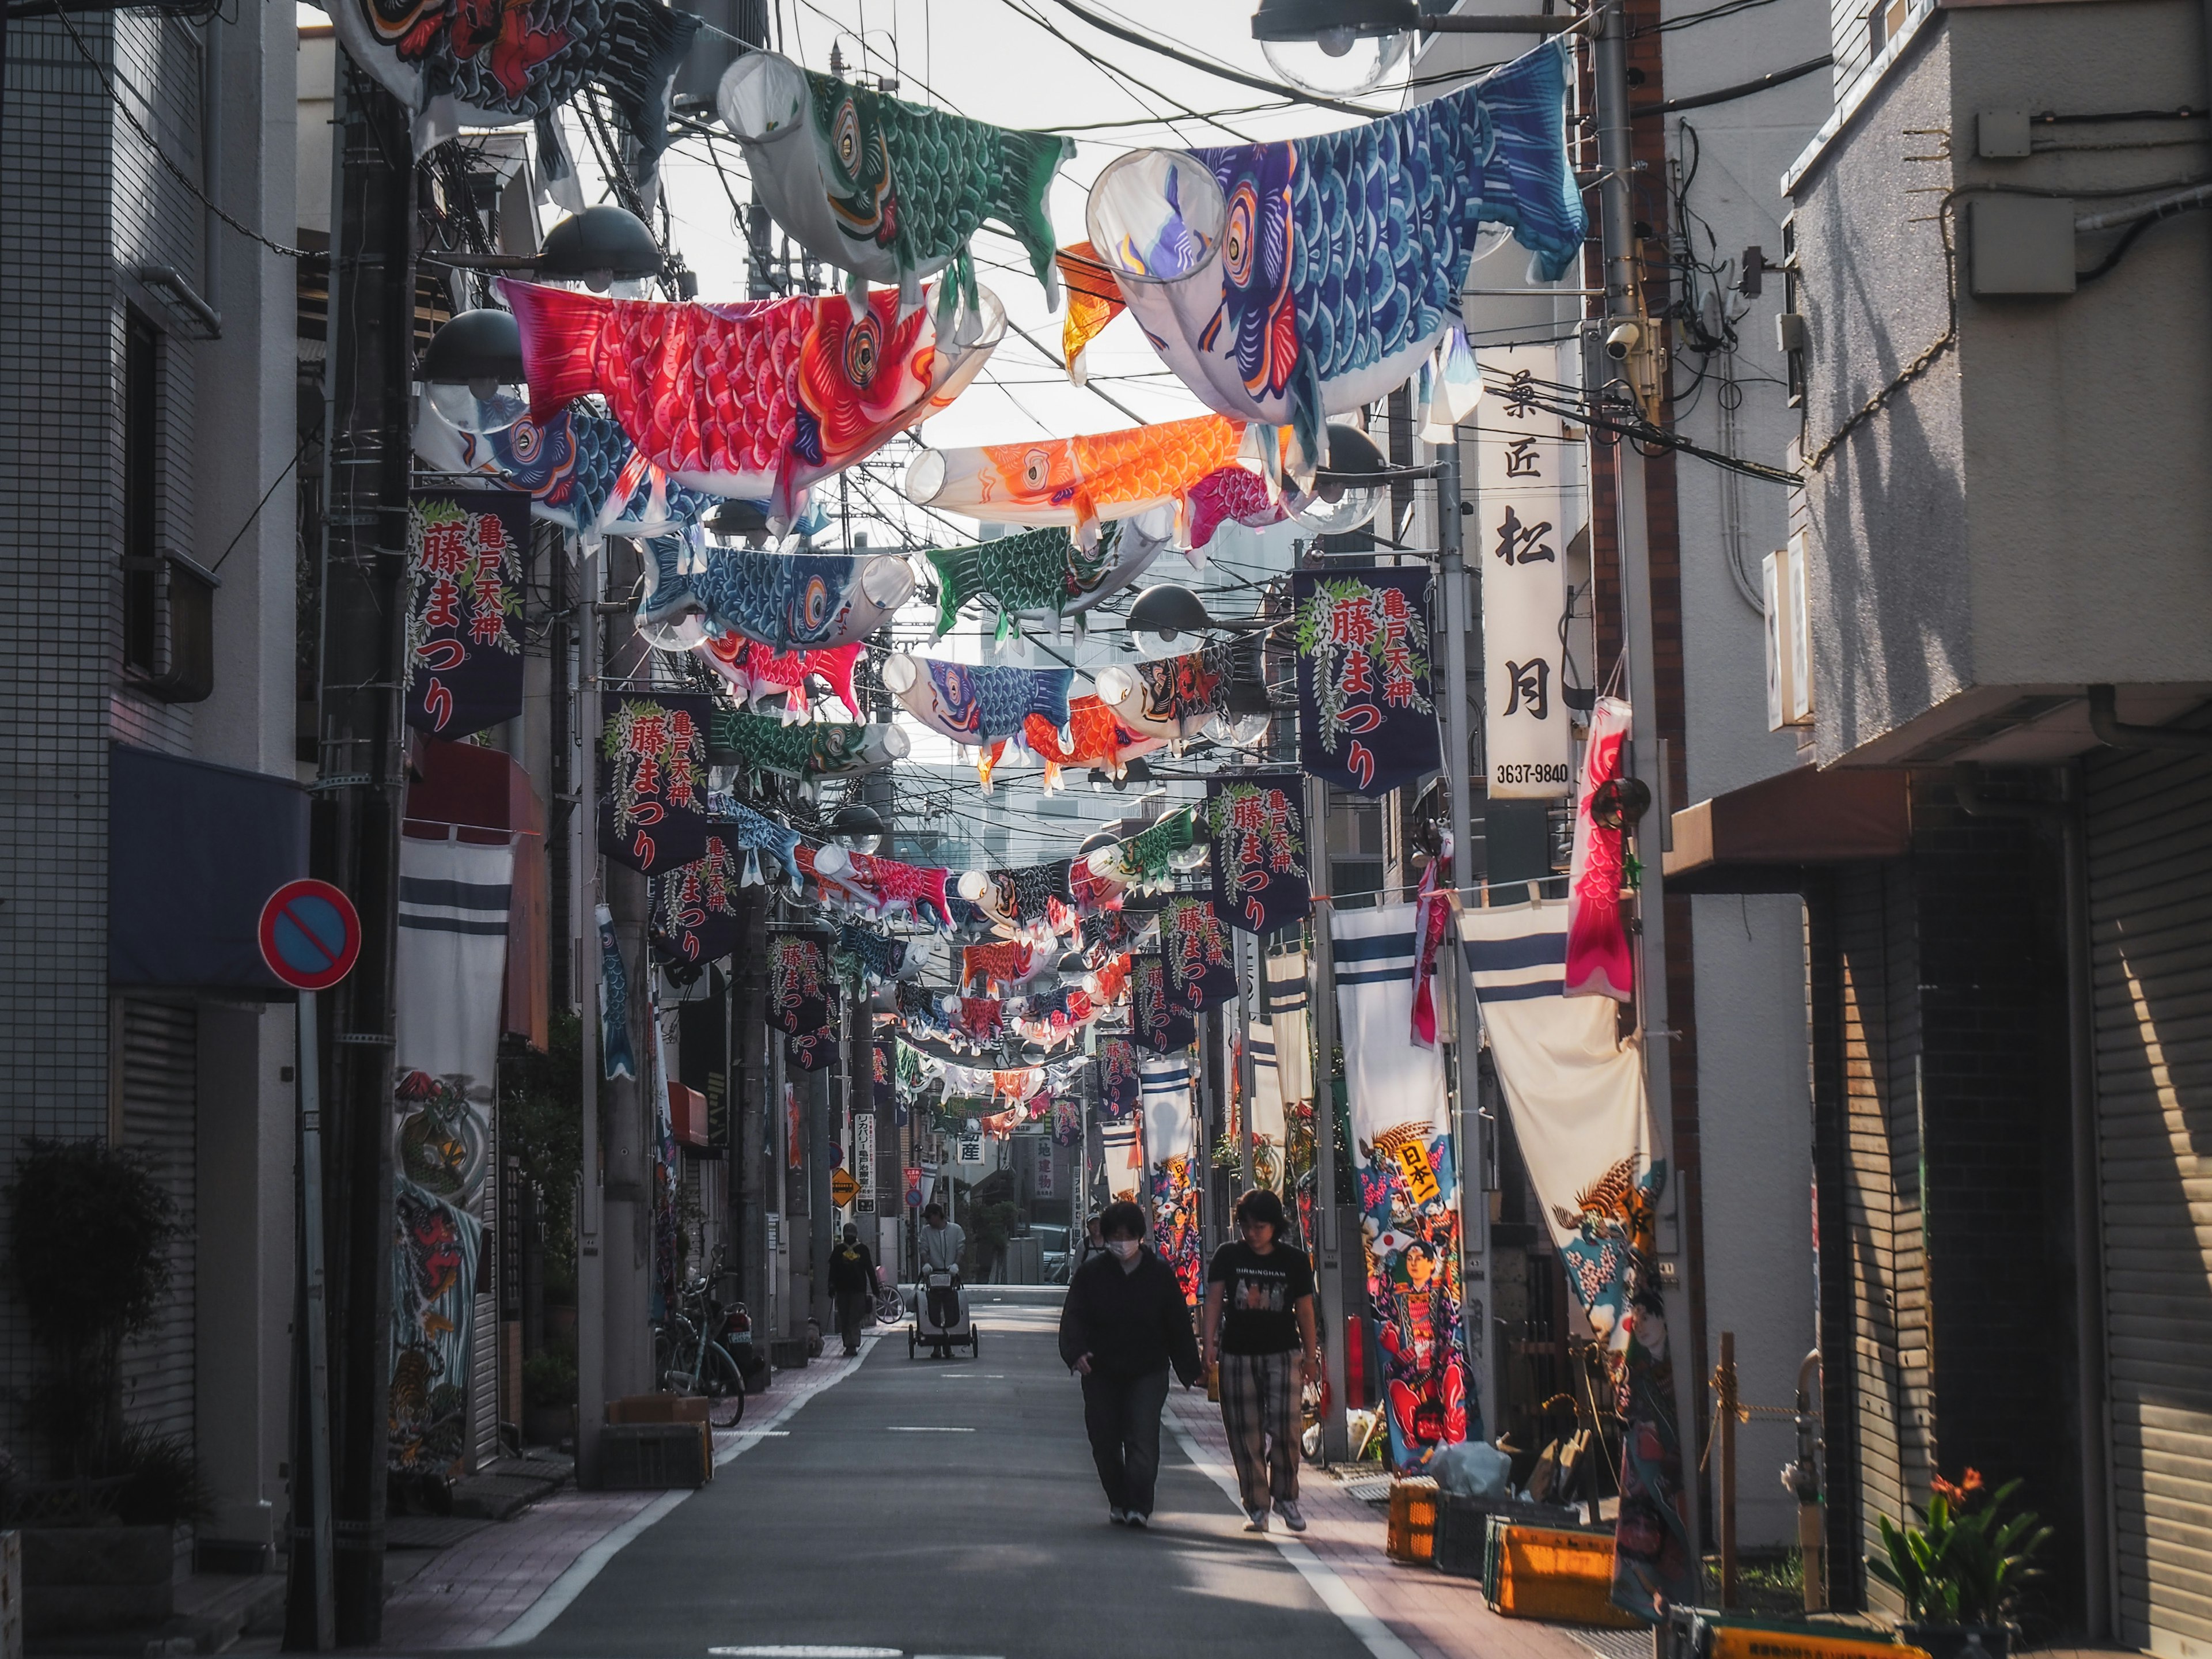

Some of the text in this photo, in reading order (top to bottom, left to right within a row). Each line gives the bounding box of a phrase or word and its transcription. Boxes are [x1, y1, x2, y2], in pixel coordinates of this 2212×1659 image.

[1503, 369, 1541, 478] 菓匠
[469, 513, 506, 646] 亀戸天神
[1495, 505, 1555, 719] 松月
[417, 521, 473, 732] 藤まつり
[1382, 588, 1413, 707] 亀戸天神
[1331, 599, 1381, 789] 藤まつり
[629, 716, 670, 871] 藤まつり
[666, 710, 694, 808] 亀戸天神
[1497, 763, 1568, 783] 3637-9840
[1233, 796, 1270, 930] 藤まつり
[1268, 789, 1290, 873] 亀戸天神
[707, 836, 726, 912] 亀戸天神
[782, 944, 802, 1033] 藤まつり
[803, 941, 817, 997] 亀戸天神
[1178, 906, 1206, 1009] 藤まつり
[1147, 967, 1171, 1052] 藤まつり
[873, 1048, 882, 1083] 亀戸天神
[1122, 1040, 1132, 1077] 亀戸天神
[858, 1115, 869, 1184] リカバリー亀戸治療室
[1038, 1137, 1051, 1188] 地建物
[1175, 1164, 1187, 1187] 日本一
[1400, 1146, 1434, 1197] 日本一
[1236, 1267, 1286, 1277] BIRMINGHAM
